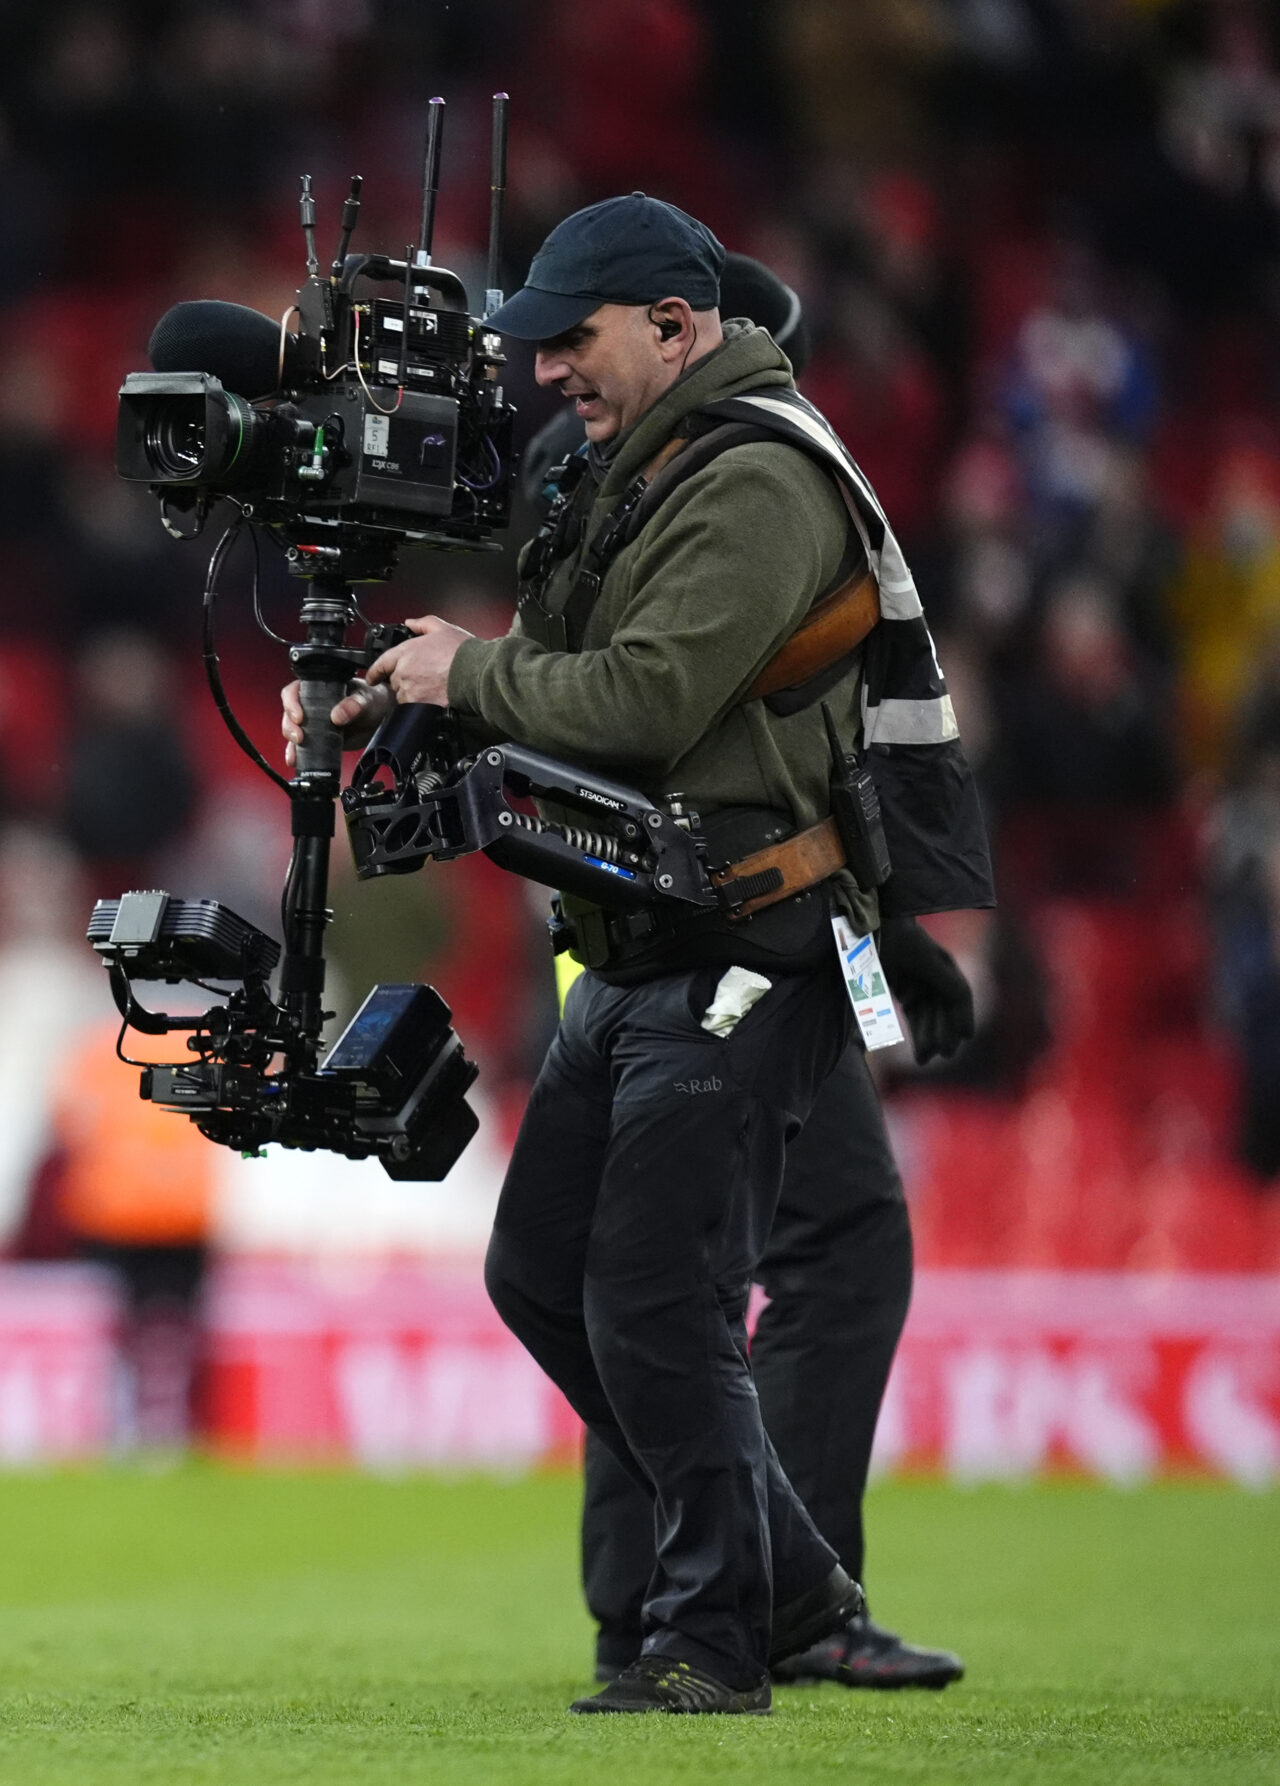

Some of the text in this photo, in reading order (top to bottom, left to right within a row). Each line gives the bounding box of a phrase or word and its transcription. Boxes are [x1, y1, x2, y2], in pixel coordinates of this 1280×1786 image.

[580, 788, 620, 809] STEADICAM
[601, 862, 619, 874] G-70
[689, 1075, 722, 1094] Rab
